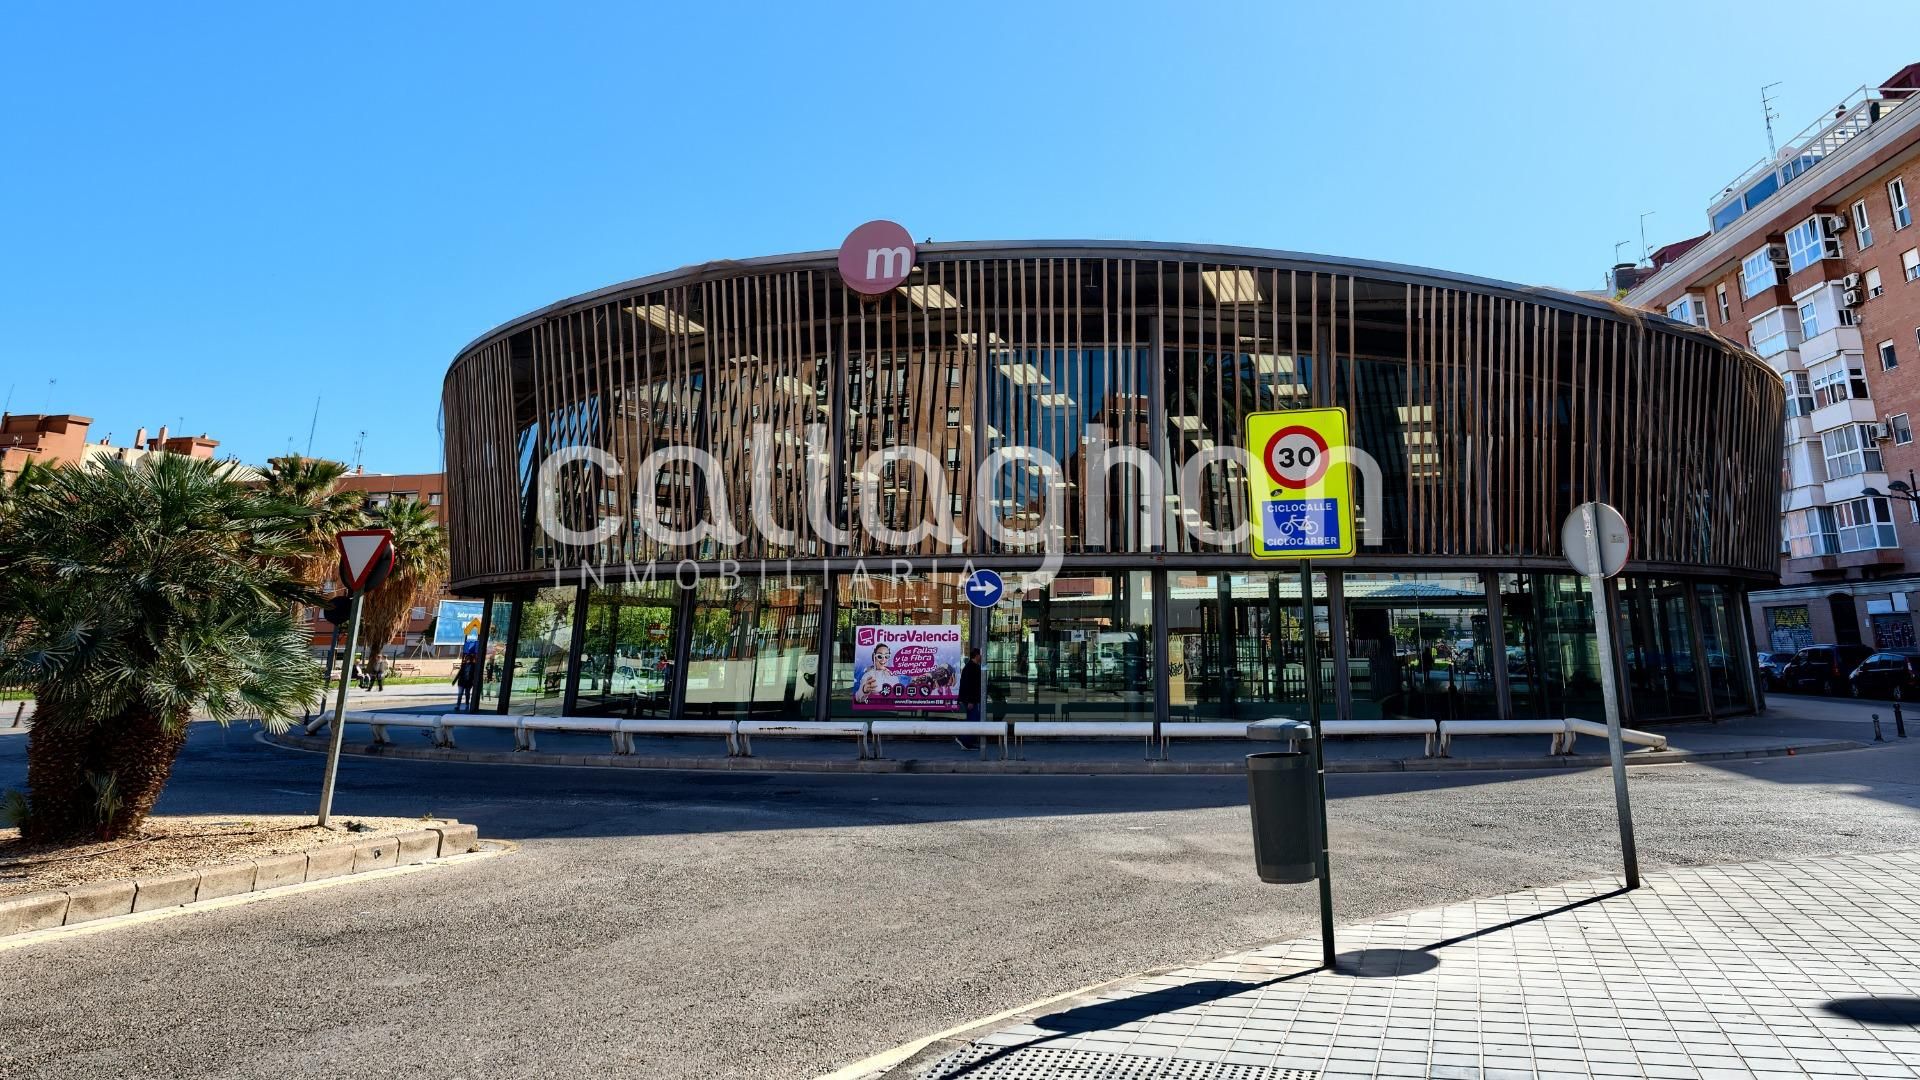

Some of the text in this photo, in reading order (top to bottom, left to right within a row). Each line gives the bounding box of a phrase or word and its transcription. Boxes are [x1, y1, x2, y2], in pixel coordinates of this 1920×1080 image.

[866, 246, 911, 280] m
[1278, 446, 1316, 468] 30
[1267, 503, 1333, 513] CICLOCALLE
[1266, 536, 1337, 547] CICLOCARRER
[876, 629, 959, 642] FibraValencia
